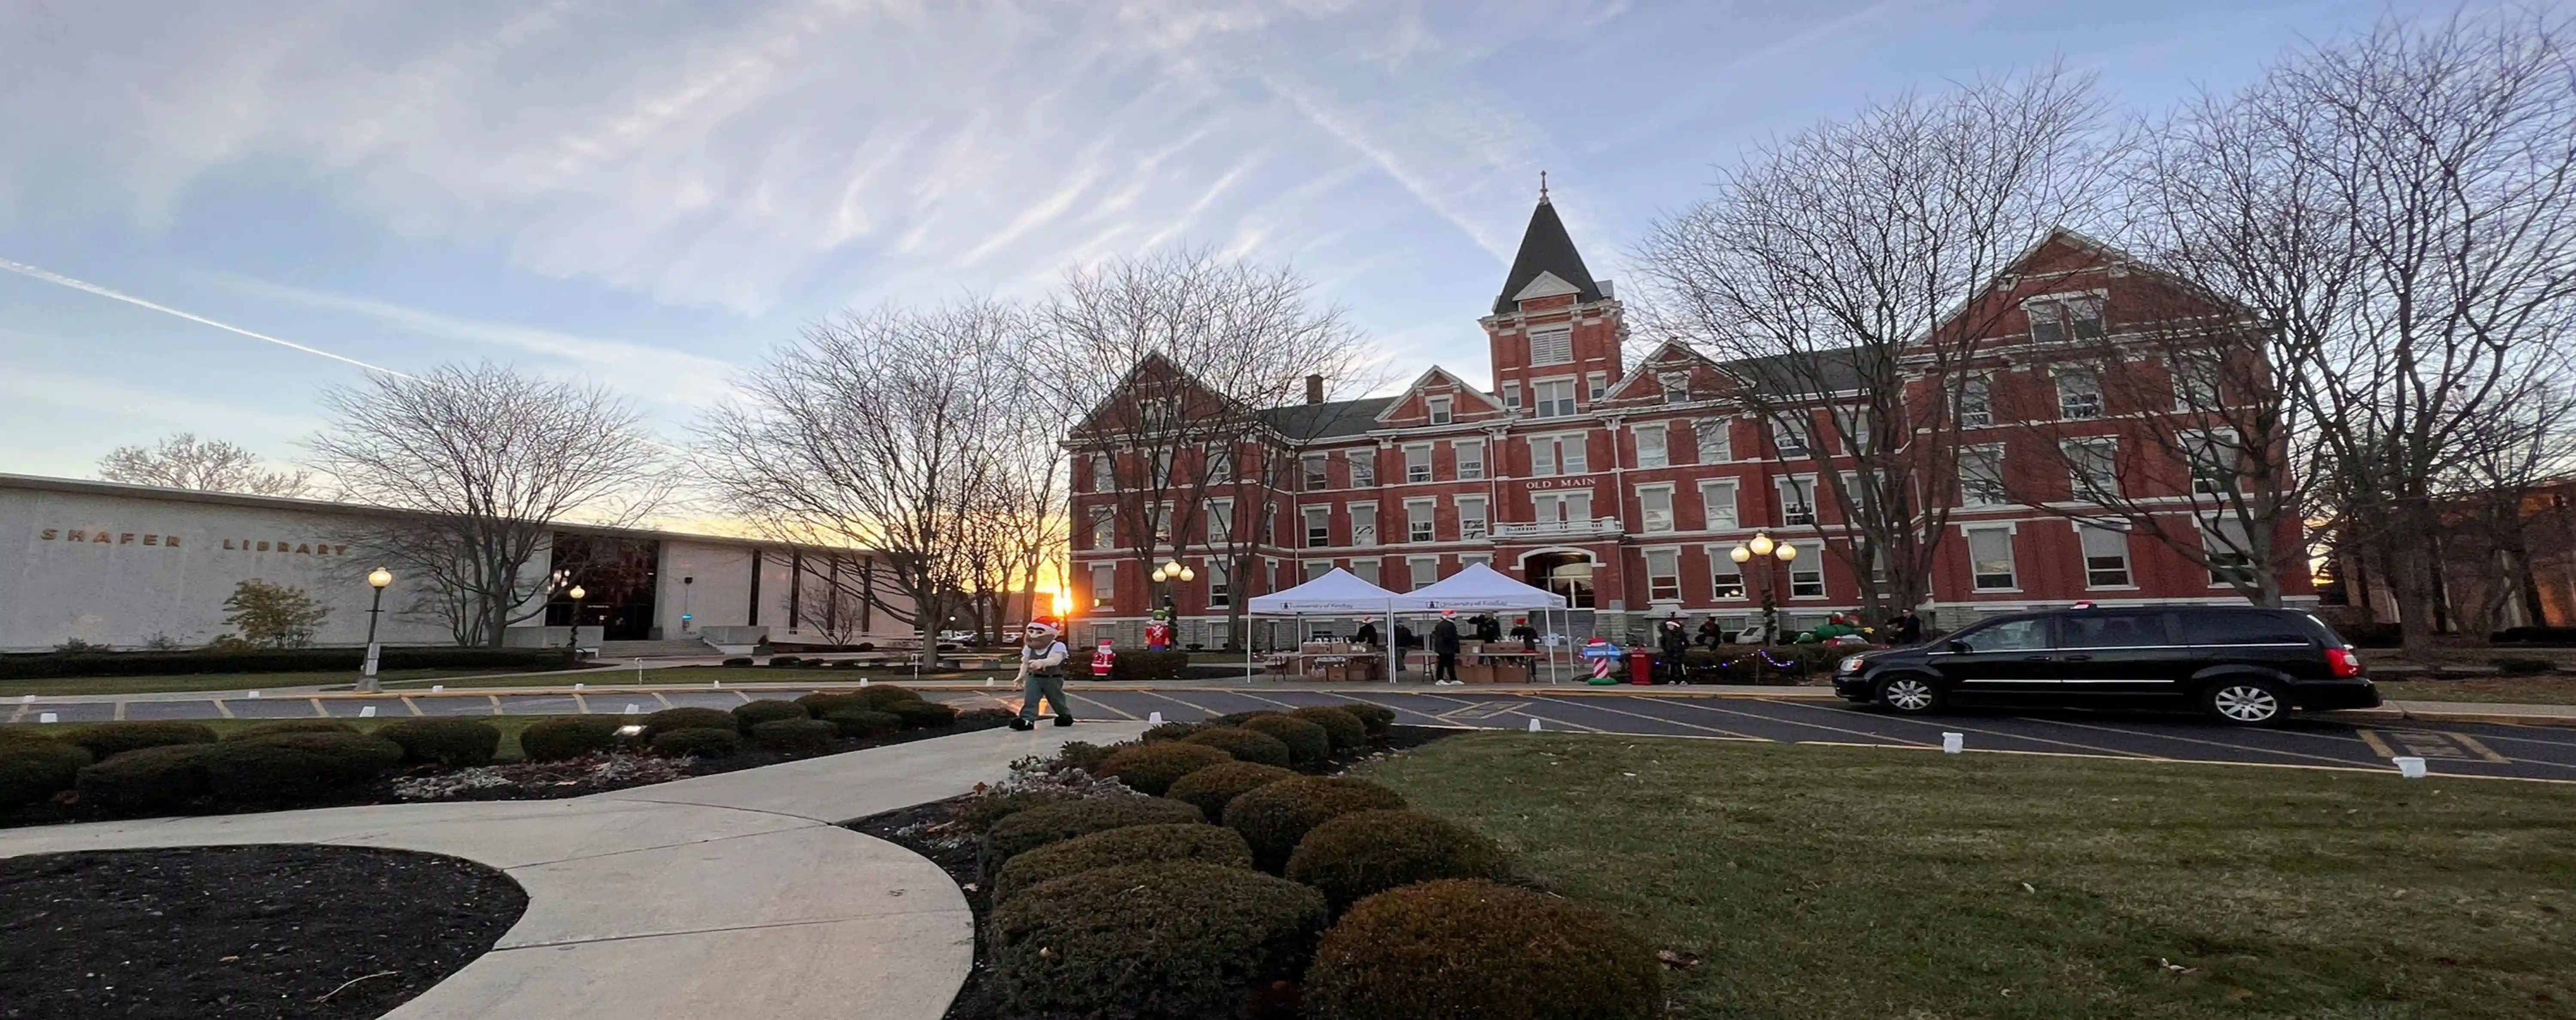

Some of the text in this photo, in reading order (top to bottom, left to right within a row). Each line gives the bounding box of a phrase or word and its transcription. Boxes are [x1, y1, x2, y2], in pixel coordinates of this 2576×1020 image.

[1526, 478, 1596, 489] OLD MAIN
[41, 528, 347, 555] SHAFER LIBRARY
